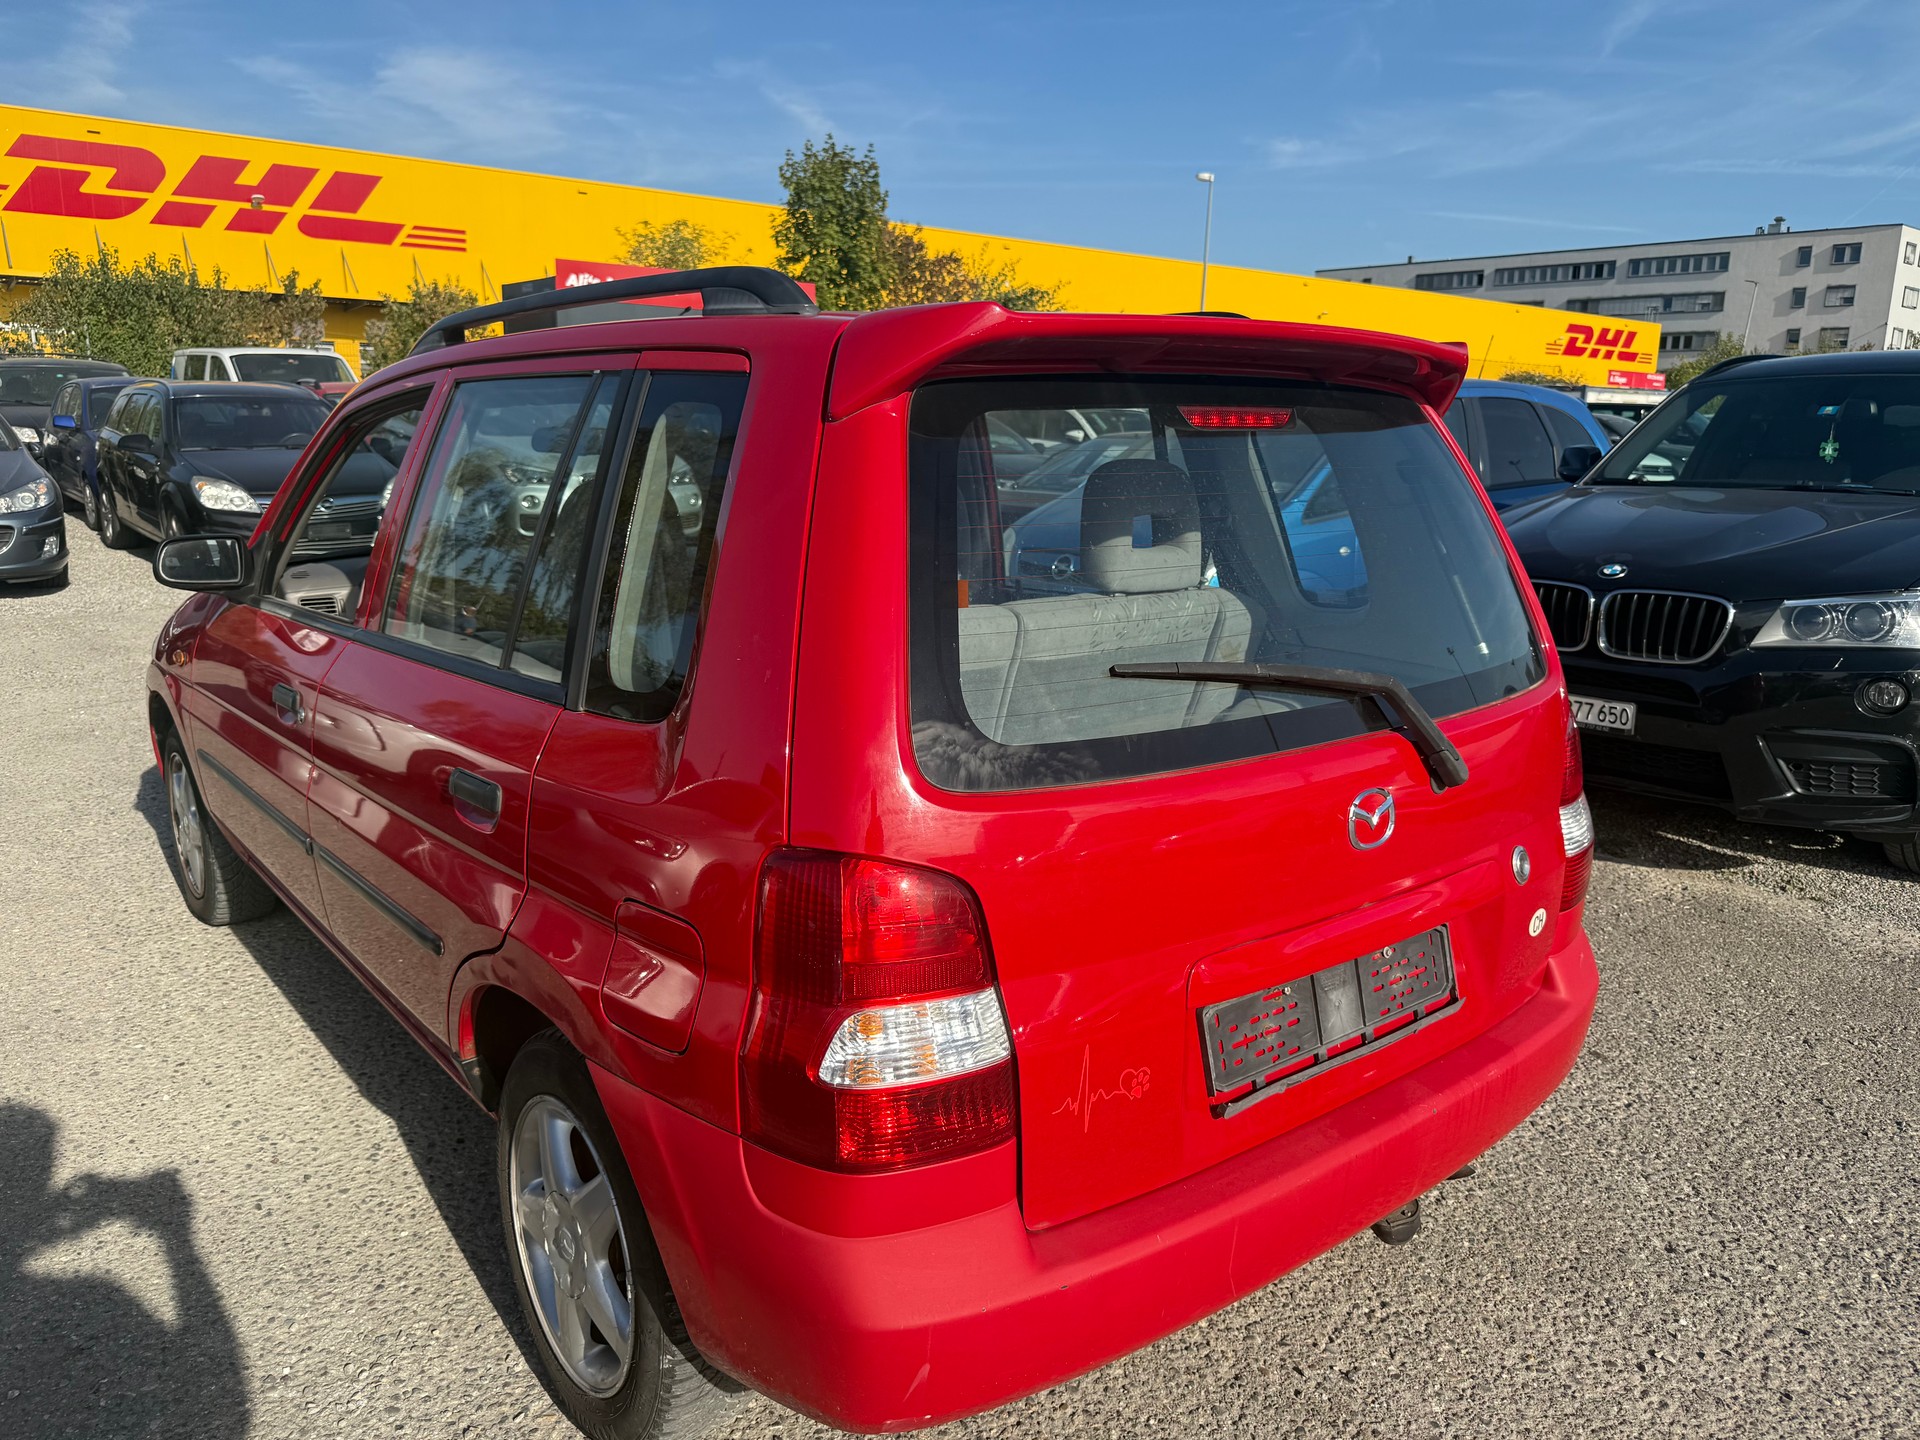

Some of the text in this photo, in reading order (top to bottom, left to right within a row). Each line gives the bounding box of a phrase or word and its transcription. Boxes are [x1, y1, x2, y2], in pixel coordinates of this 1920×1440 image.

[2, 133, 405, 246] DHL
[1562, 323, 1639, 362] DHL
[1569, 700, 1629, 726] 77 650
[1533, 911, 1544, 933] CH
